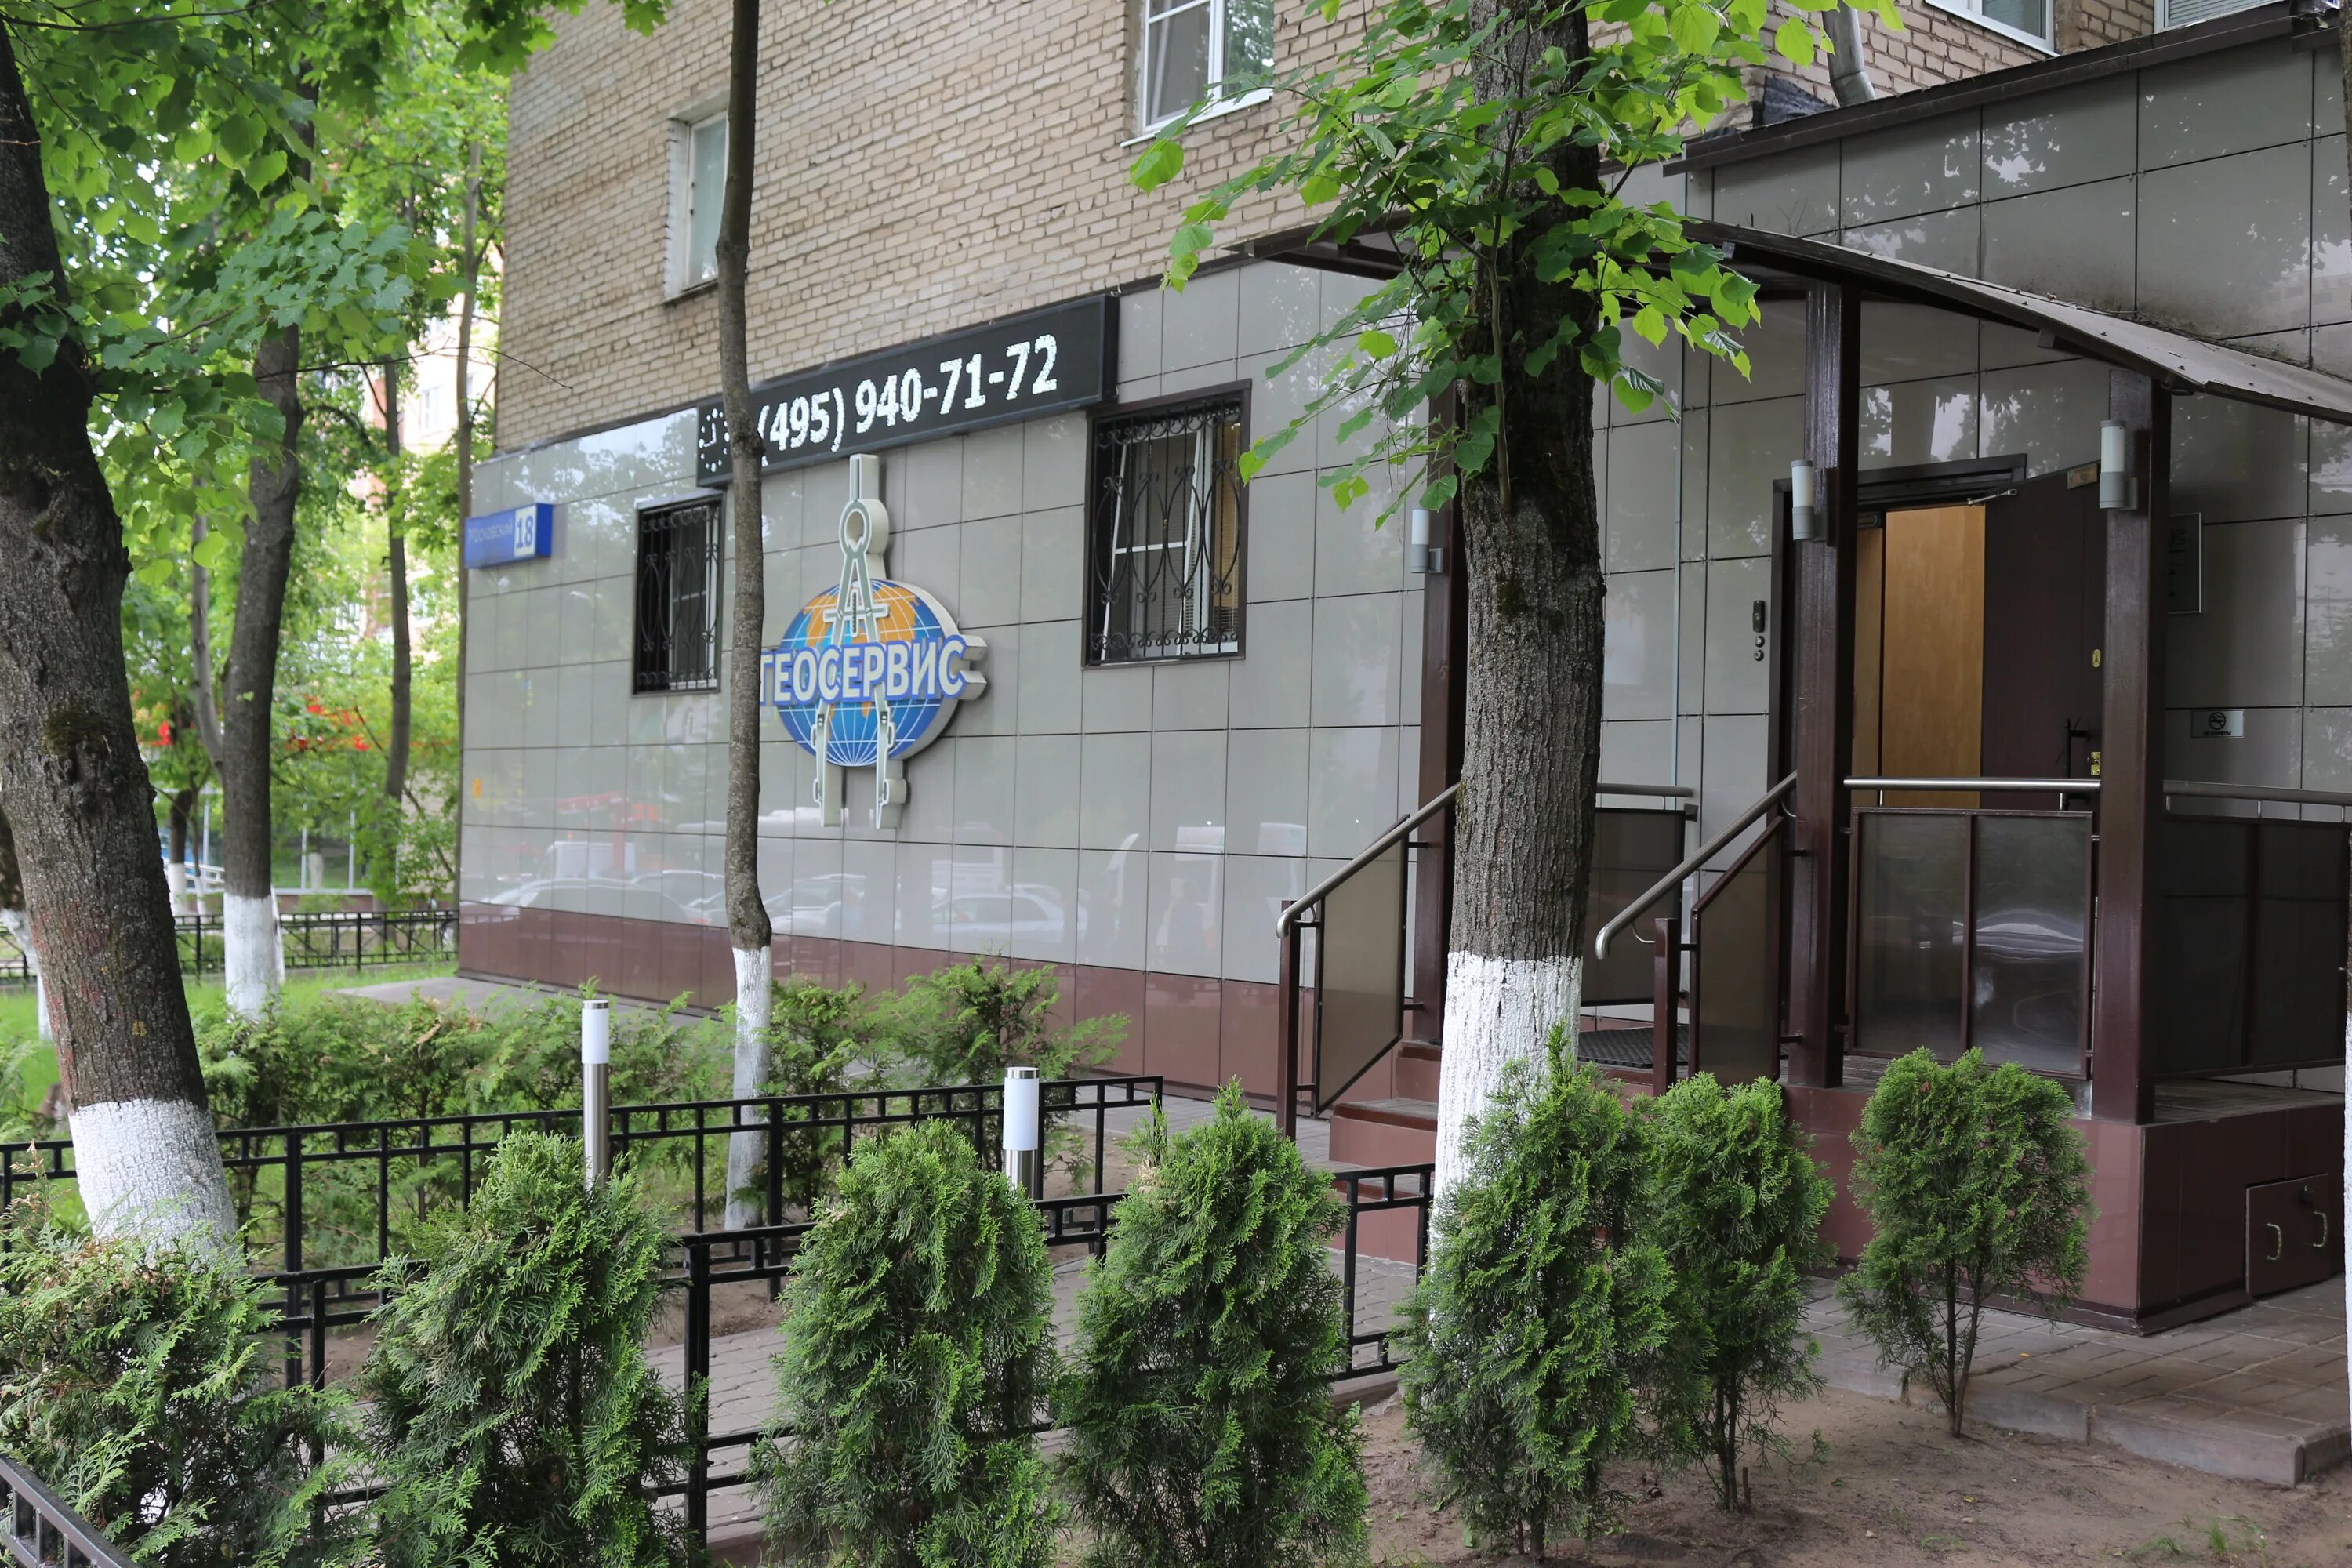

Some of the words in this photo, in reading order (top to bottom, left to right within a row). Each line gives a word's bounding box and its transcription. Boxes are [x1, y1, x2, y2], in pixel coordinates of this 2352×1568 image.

[757, 387, 845, 467] (495)
[855, 333, 1058, 434] 940-71-72
[516, 515, 533, 549] 18
[760, 637, 966, 704] ГЕОСЕРВИС
